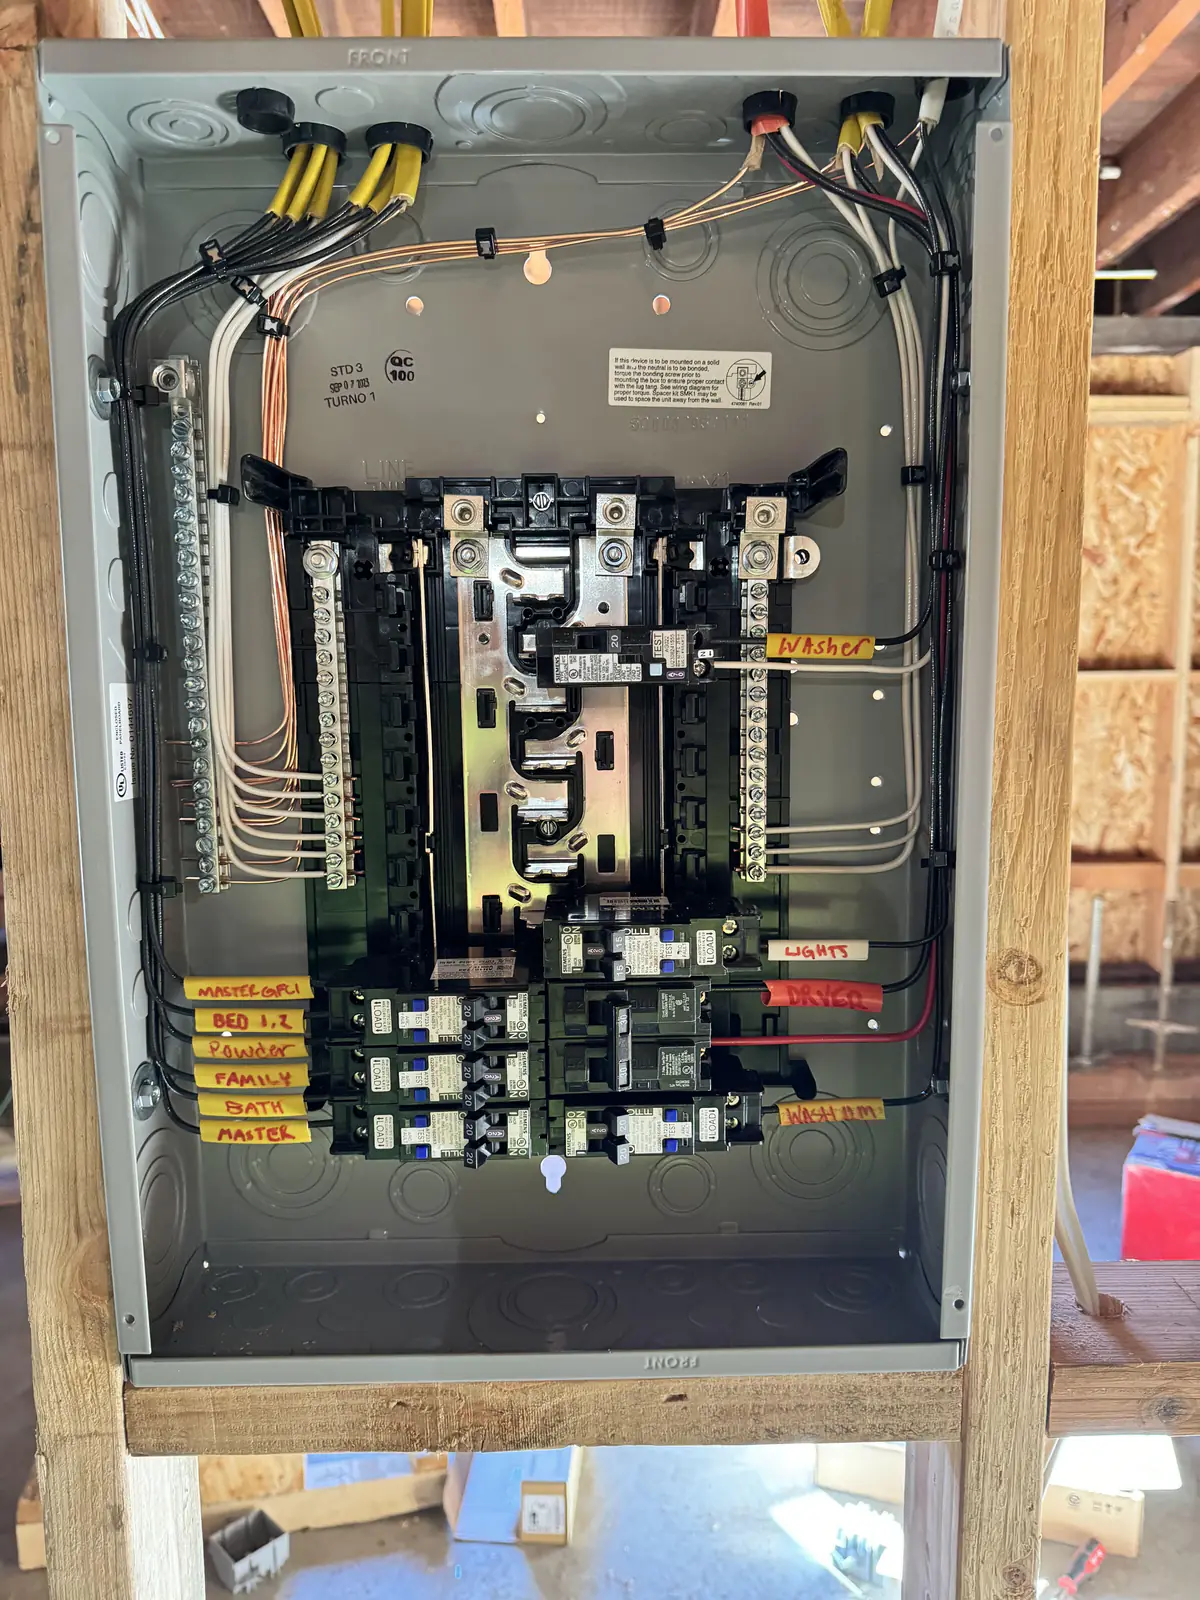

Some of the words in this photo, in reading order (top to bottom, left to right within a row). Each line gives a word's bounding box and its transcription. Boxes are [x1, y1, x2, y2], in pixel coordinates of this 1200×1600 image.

[348, 48, 412, 66] FRONT
[390, 356, 414, 367] QC
[331, 364, 353, 376] STD
[356, 363, 363, 372] 3
[390, 370, 414, 381] 100
[330, 382, 342, 393] SEP
[324, 393, 366, 408] TURNO
[370, 392, 375, 401] 1
[611, 635, 618, 648] 20
[616, 937, 623, 948] 15
[706, 936, 714, 959] LOAD
[785, 944, 848, 960] LIGHTS
[617, 965, 624, 976] 15
[199, 984, 259, 998] MASTER
[261, 983, 300, 998] GFCI
[374, 1005, 382, 1028] LOAD
[463, 1005, 471, 1018] 20
[213, 1013, 248, 1030] BED
[464, 1034, 471, 1046] 20
[373, 1063, 381, 1086] LOAD
[464, 1067, 471, 1078] 20
[215, 1072, 291, 1087] FAMILY
[464, 1094, 472, 1107] 20
[225, 1100, 284, 1115] BATH
[376, 1120, 384, 1143] LOAD
[466, 1124, 473, 1136] 20
[620, 1120, 626, 1131] 20
[217, 1124, 296, 1142] MASTER
[466, 1152, 473, 1165] 20
[620, 1149, 627, 1160] 20
[644, 1356, 700, 1369] FRONT
